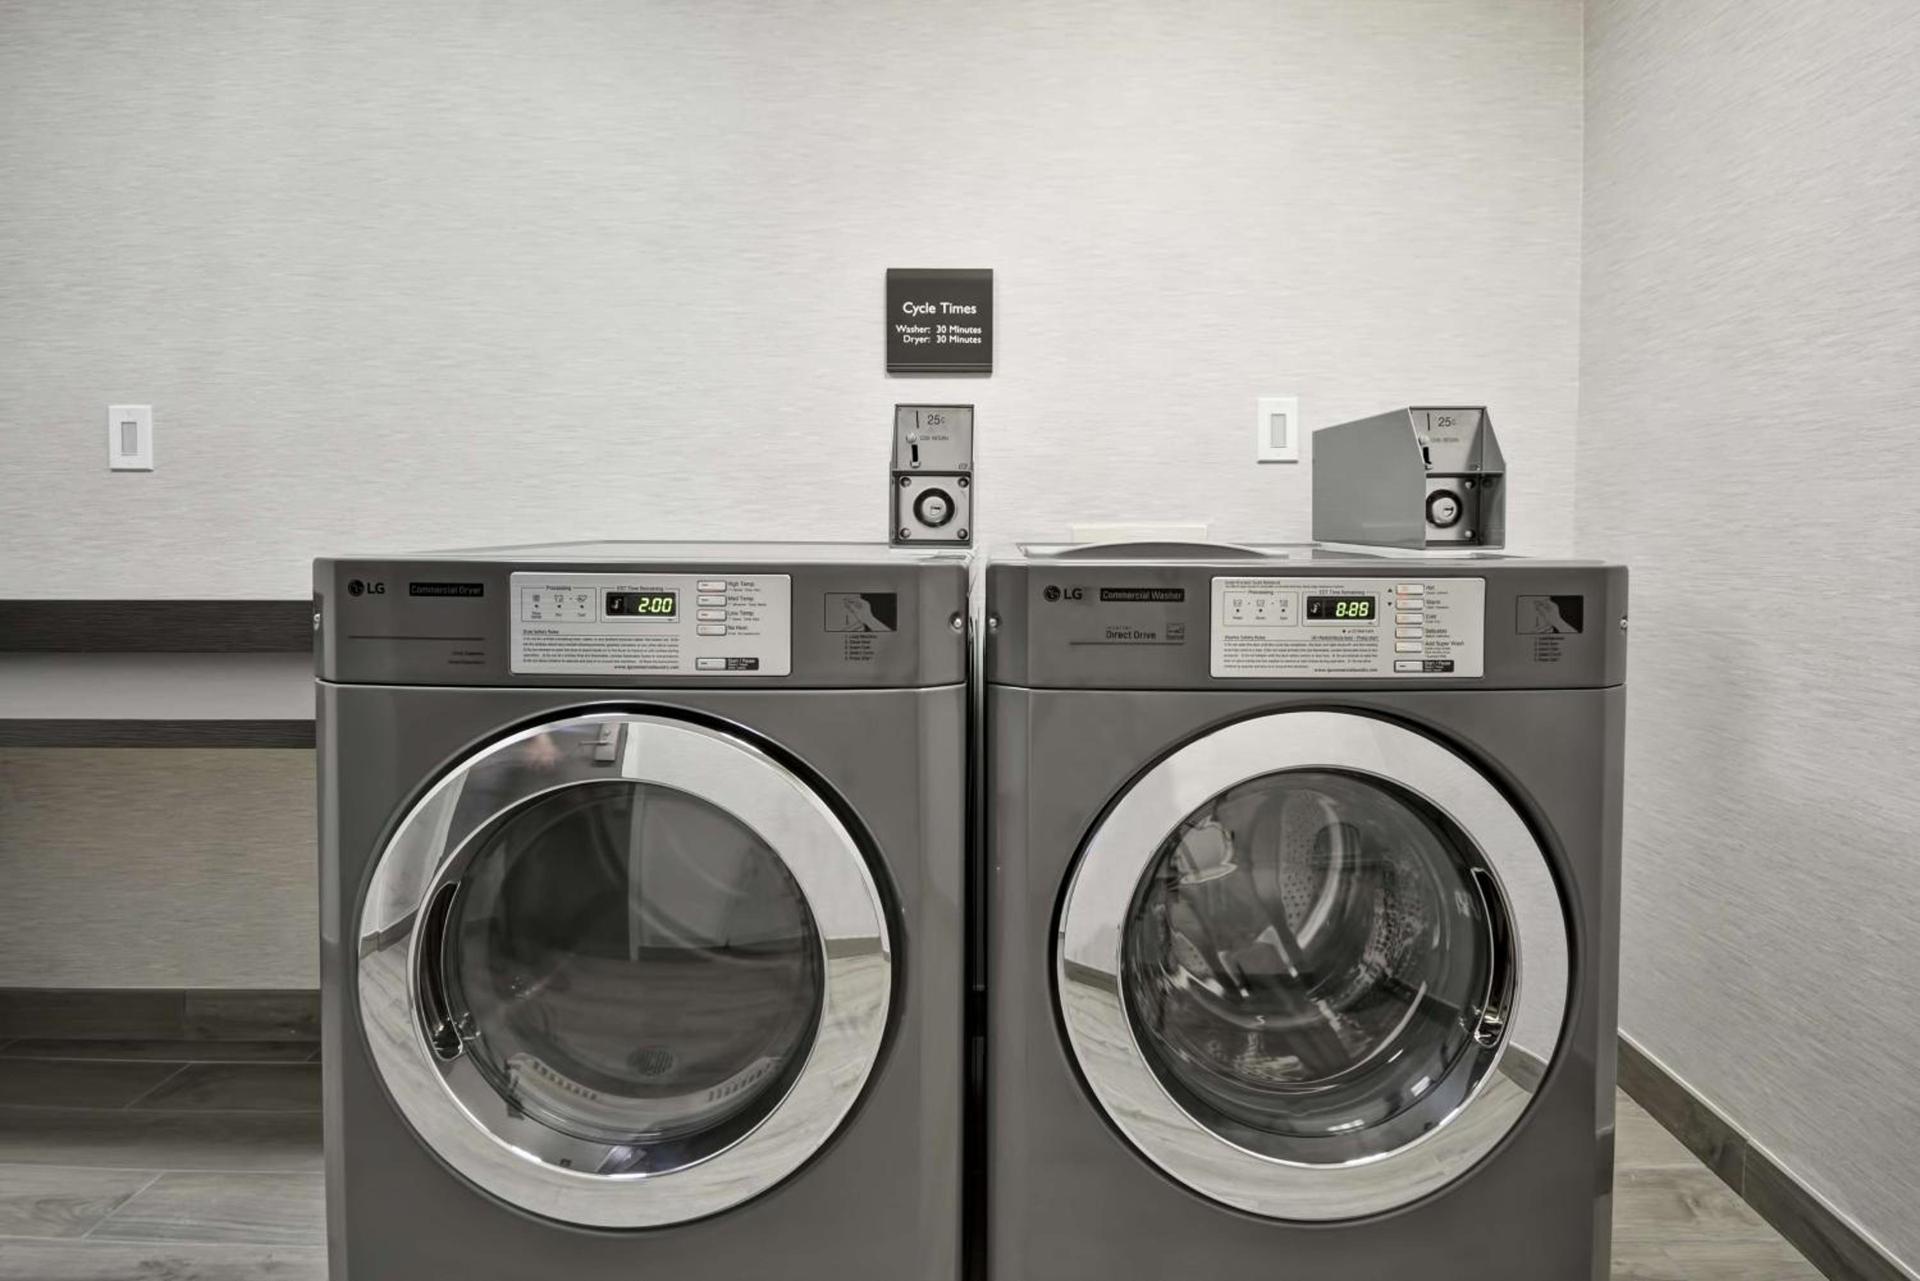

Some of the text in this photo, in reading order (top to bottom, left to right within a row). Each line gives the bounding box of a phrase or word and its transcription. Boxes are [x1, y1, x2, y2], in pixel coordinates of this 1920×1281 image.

[902, 301, 977, 317] Cycle Times
[895, 324, 982, 334] Washer: 30 Minutes
[903, 335, 982, 346] Dryer: 30 Minutes
[367, 582, 385, 594] LG
[411, 585, 458, 594] Commercial
[1063, 588, 1083, 600] LG
[1102, 590, 1150, 600] Commercial
[1105, 630, 1132, 640] Direct
[1134, 630, 1157, 640] Drive
